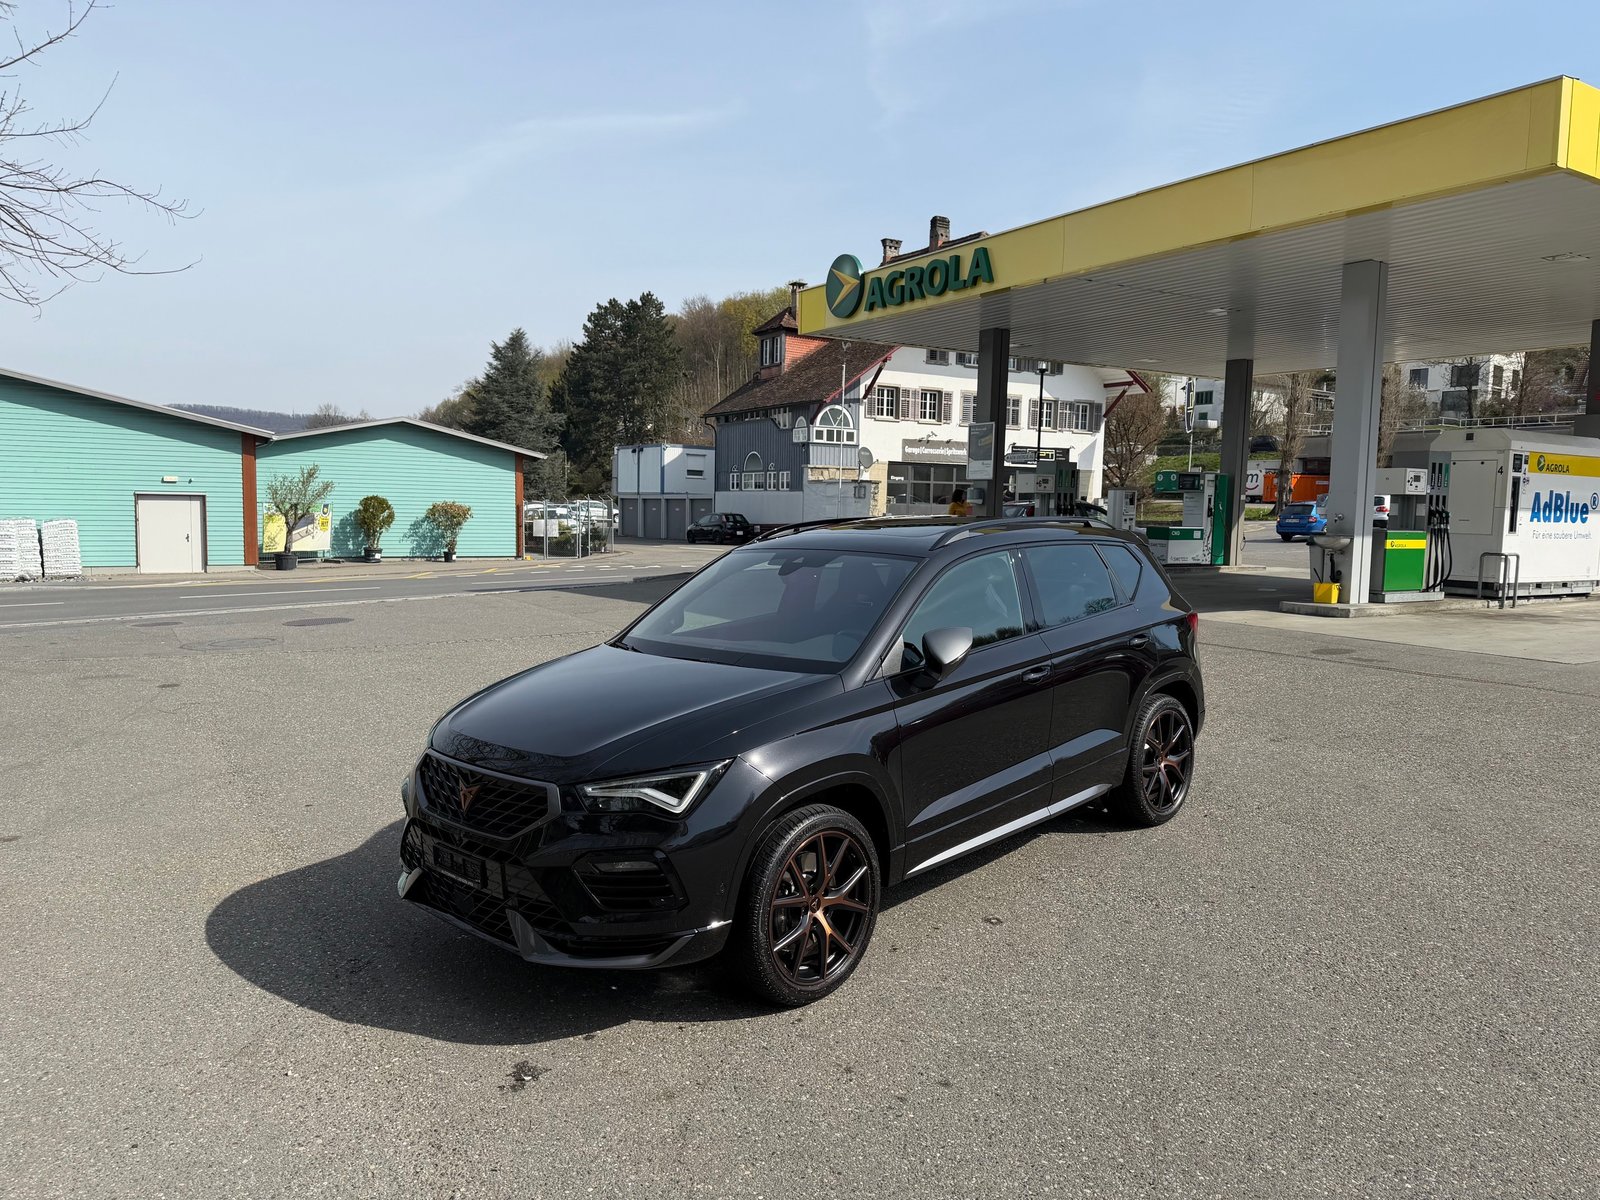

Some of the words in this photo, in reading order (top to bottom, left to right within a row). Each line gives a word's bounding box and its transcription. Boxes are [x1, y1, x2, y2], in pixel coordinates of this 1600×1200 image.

[864, 246, 994, 312] AGROLA
[1497, 466, 1503, 475] 4
[1546, 463, 1570, 473] AGROLA
[1532, 530, 1541, 539] Für
[1542, 530, 1553, 539] eine
[1553, 530, 1573, 540] saubere
